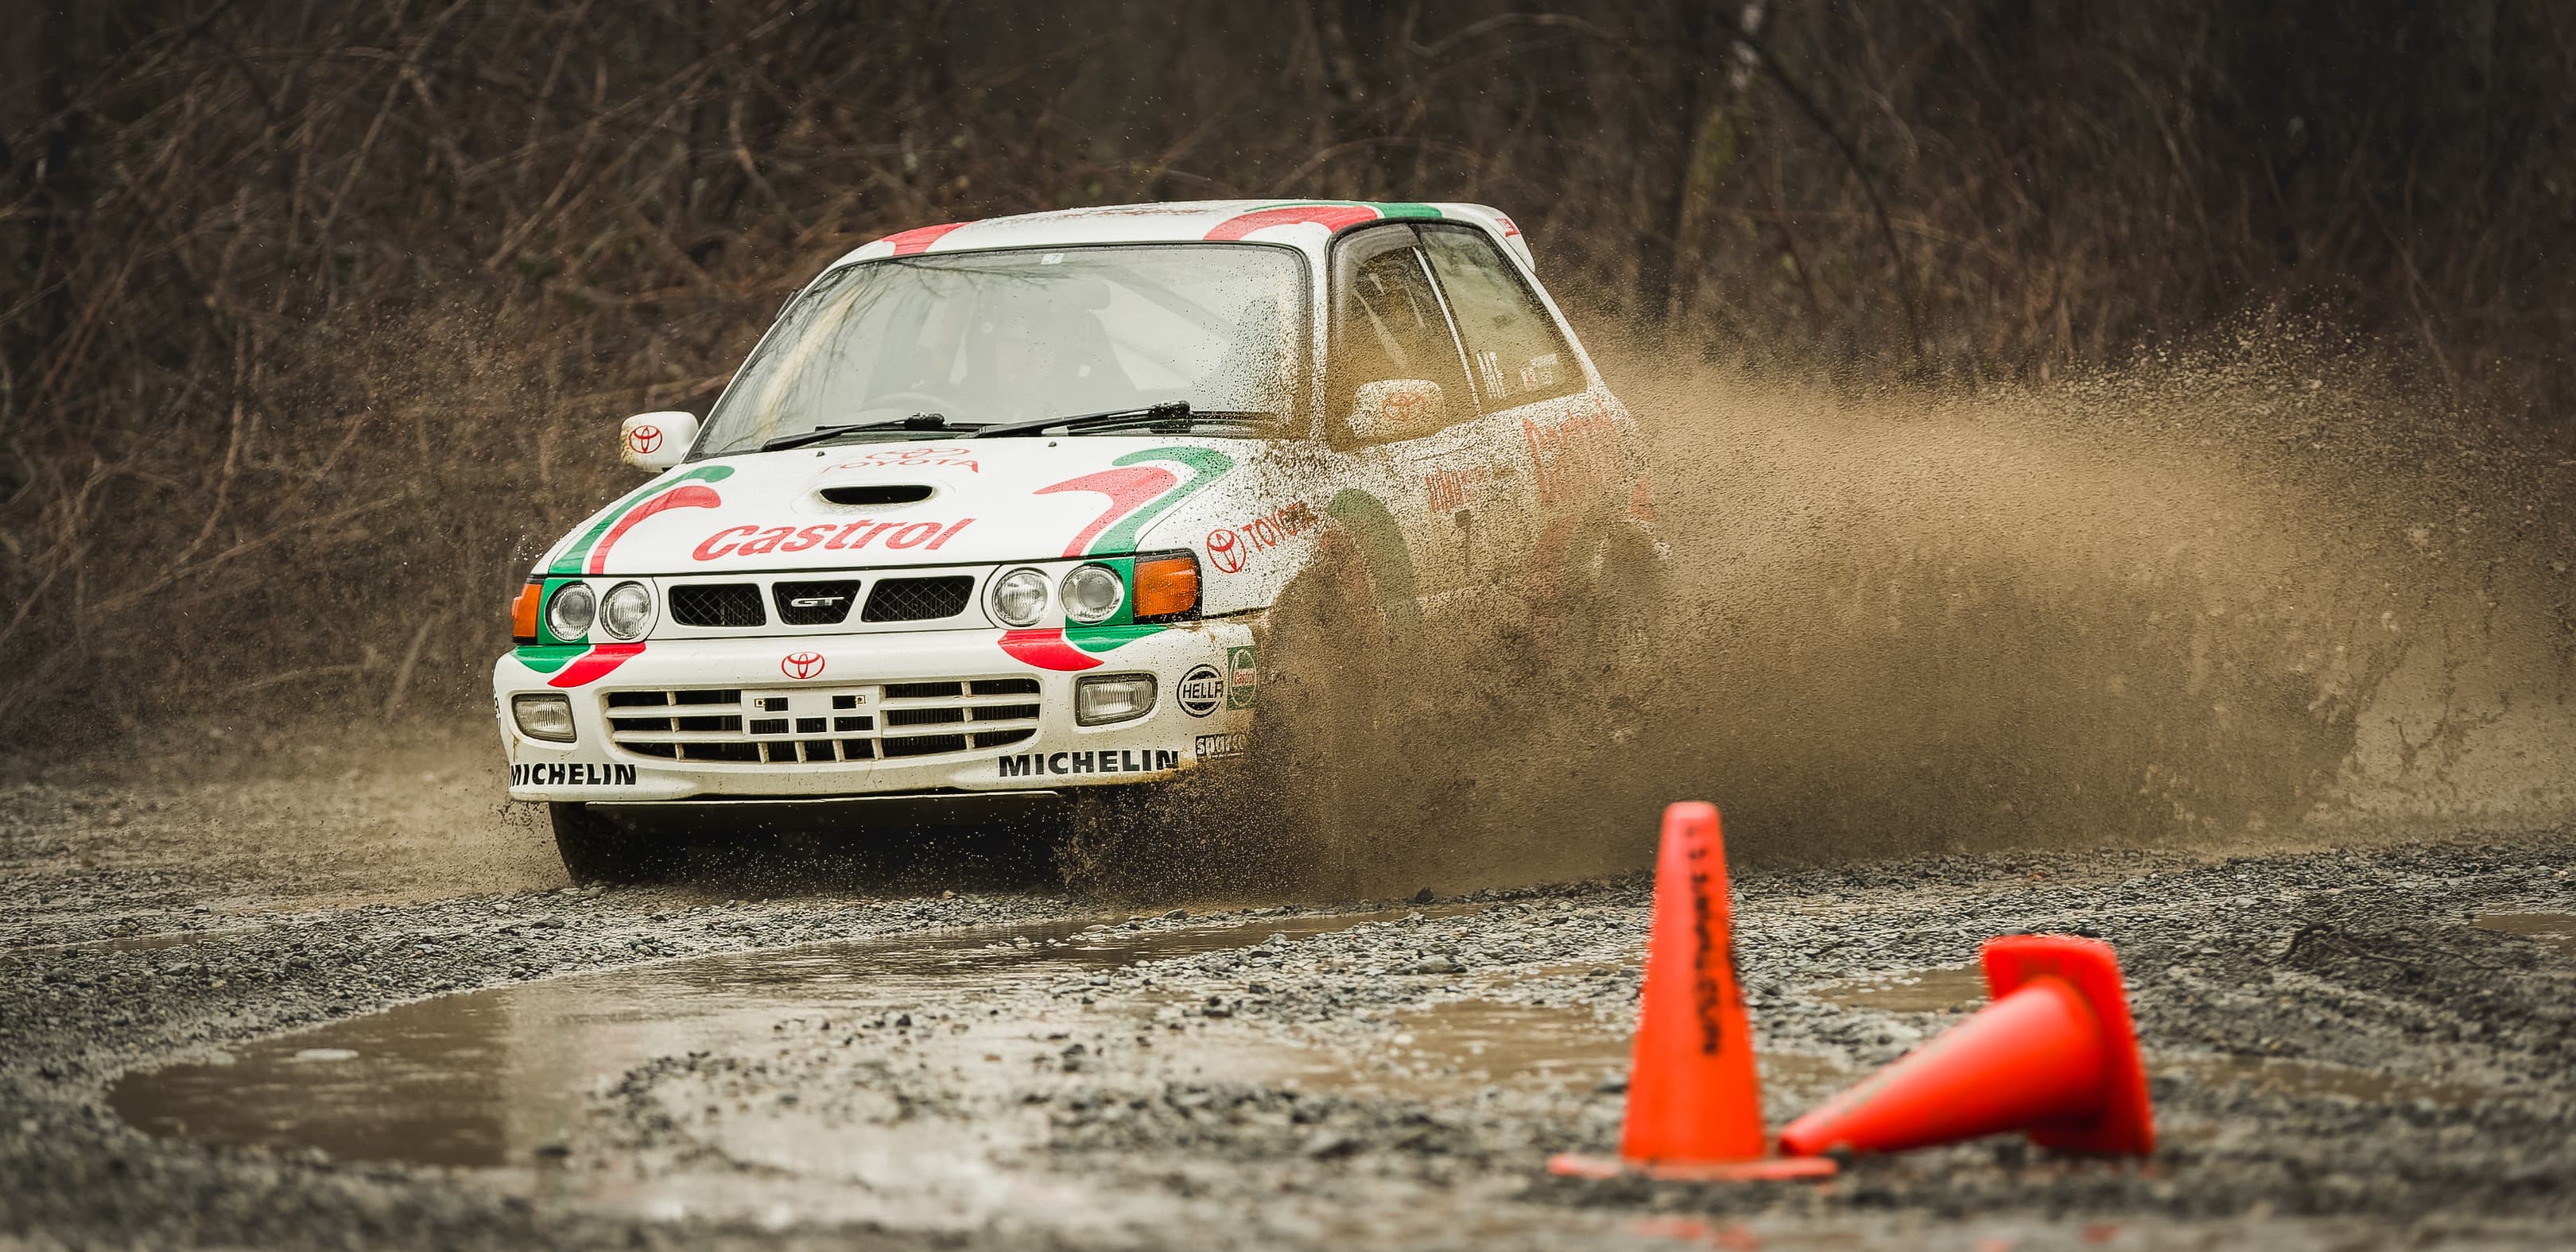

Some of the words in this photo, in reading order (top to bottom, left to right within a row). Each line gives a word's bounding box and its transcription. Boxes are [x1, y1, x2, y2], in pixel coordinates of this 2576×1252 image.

[821, 459, 979, 474] TOYOTA
[692, 518, 976, 561] Castrol
[791, 596, 845, 607] GT
[510, 763, 637, 788] MICHELIN
[999, 749, 1180, 777] MICHELIN
